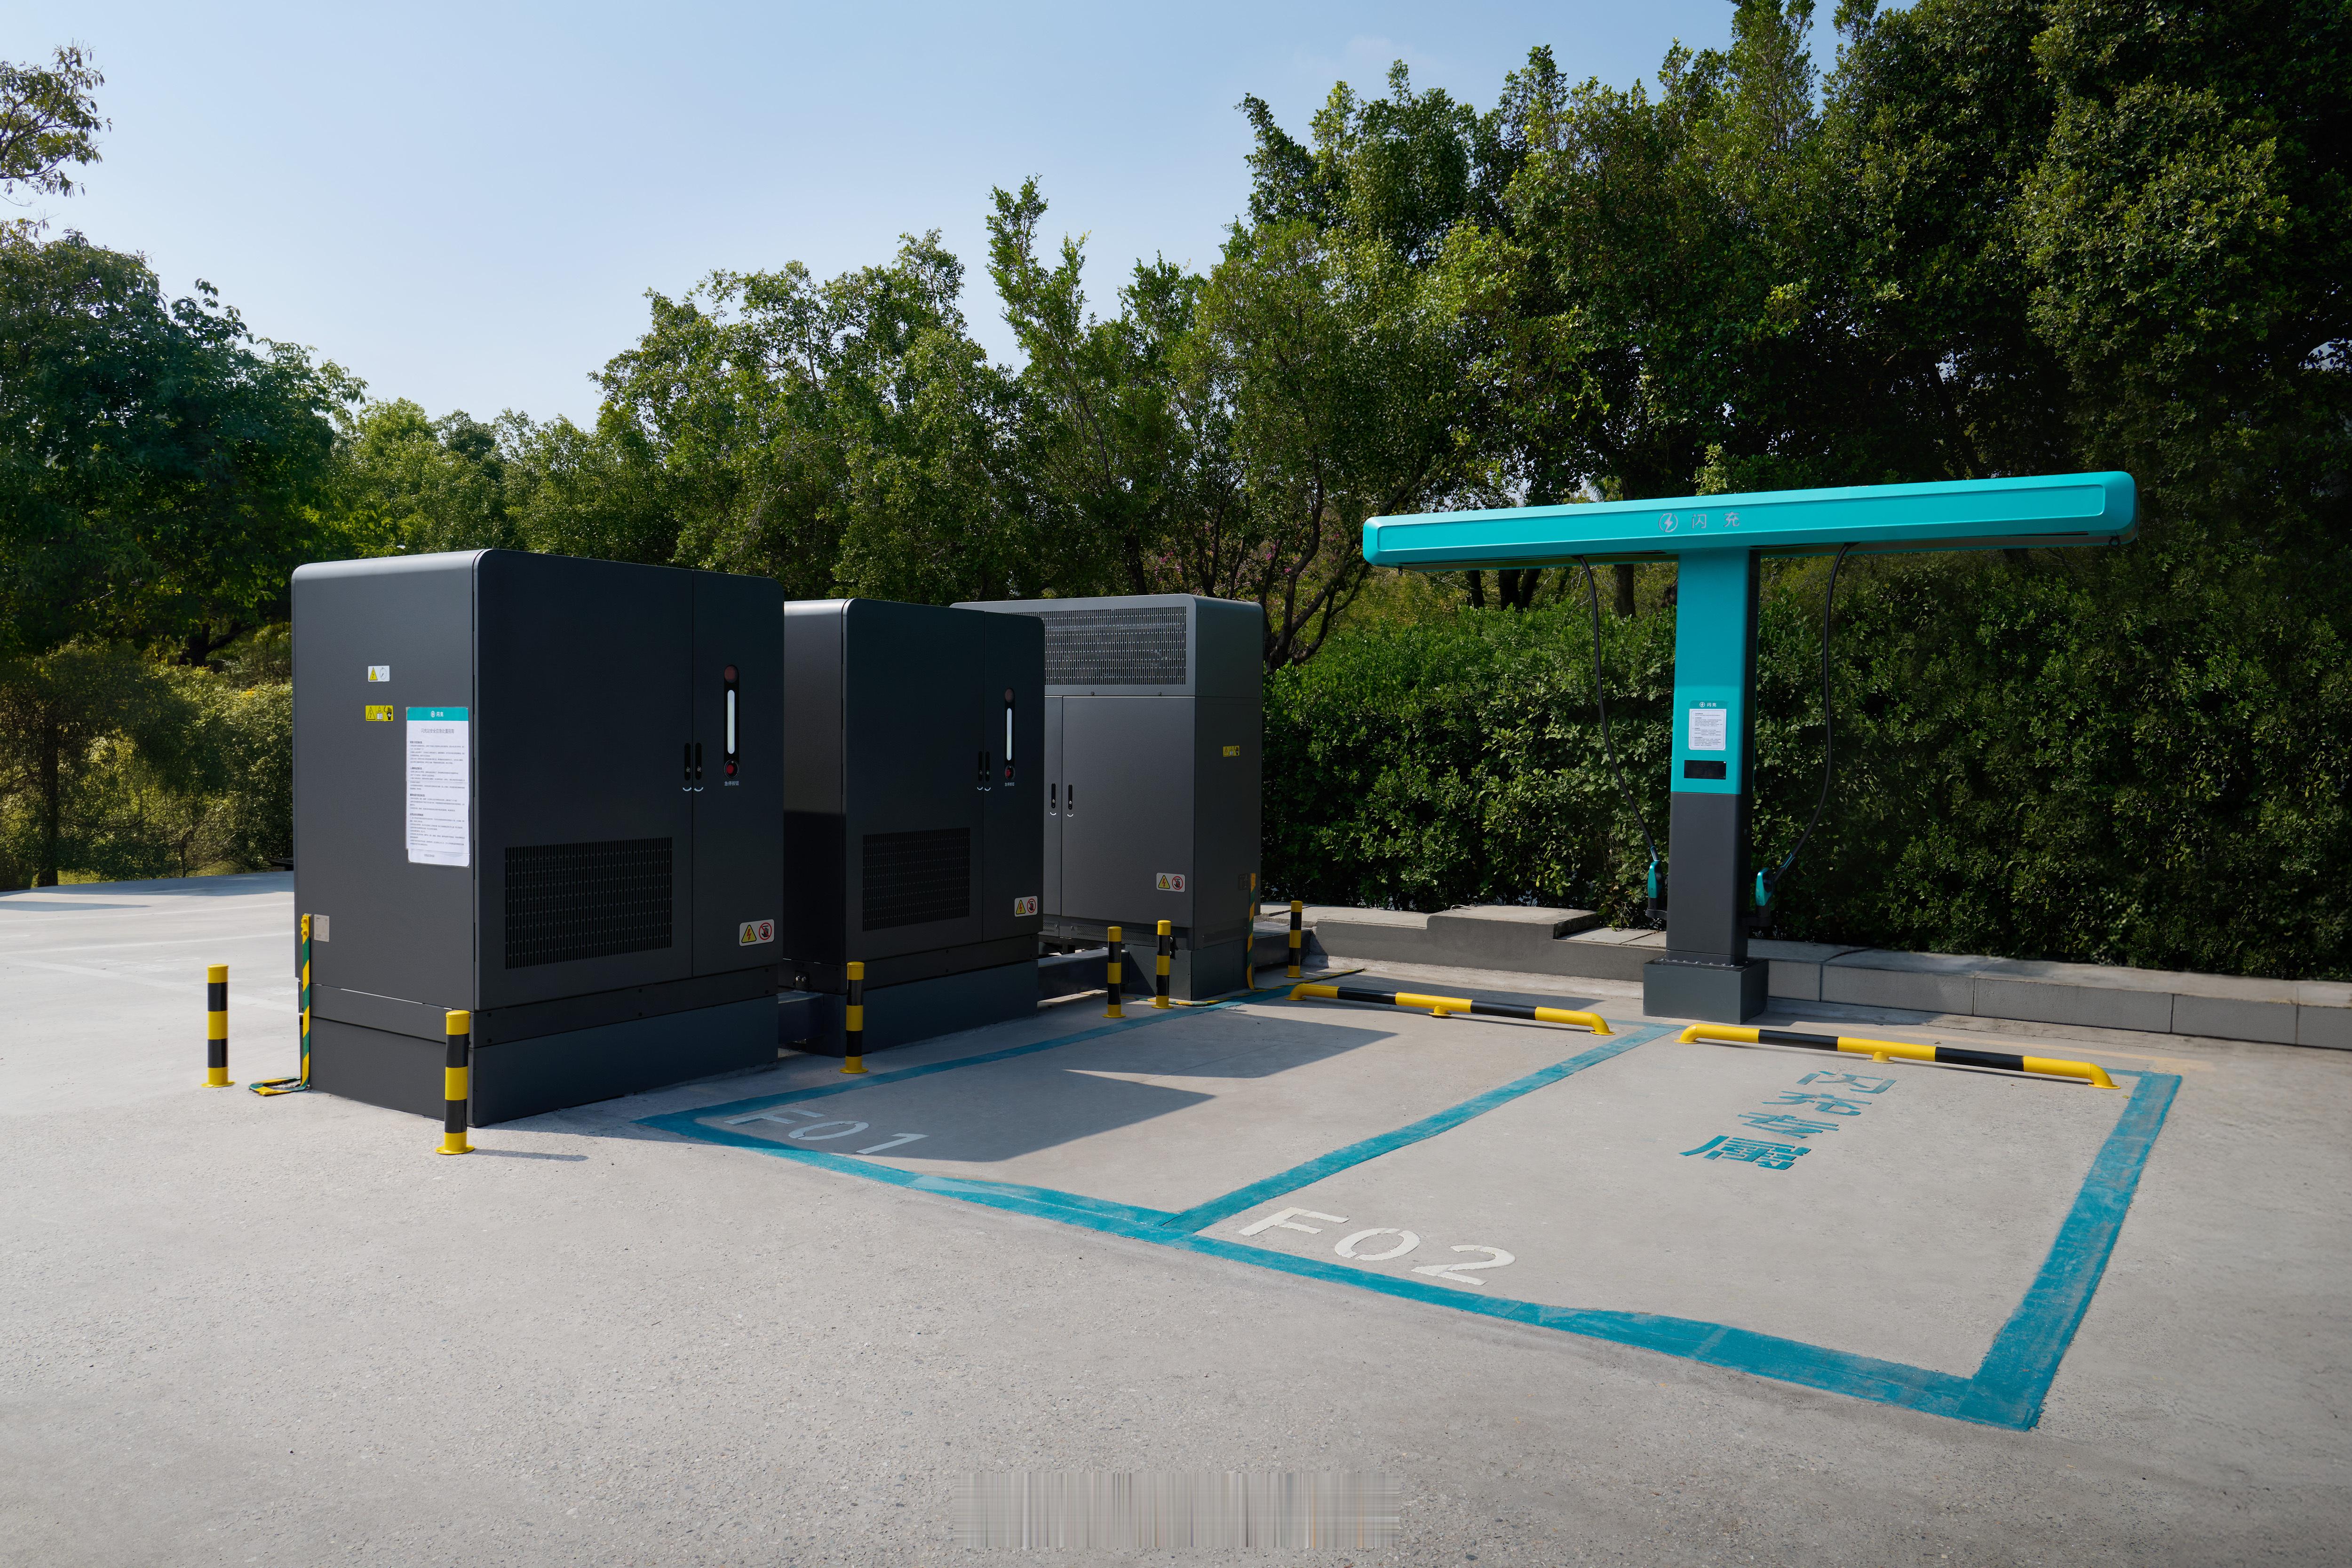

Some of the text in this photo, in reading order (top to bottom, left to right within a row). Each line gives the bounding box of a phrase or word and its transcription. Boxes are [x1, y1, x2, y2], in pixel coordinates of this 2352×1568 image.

[1692, 511, 1740, 529] 闪充
[723, 1108, 930, 1154] F01
[1679, 1071, 1897, 1170] 闪充专属
[1238, 1207, 1516, 1286] F02
